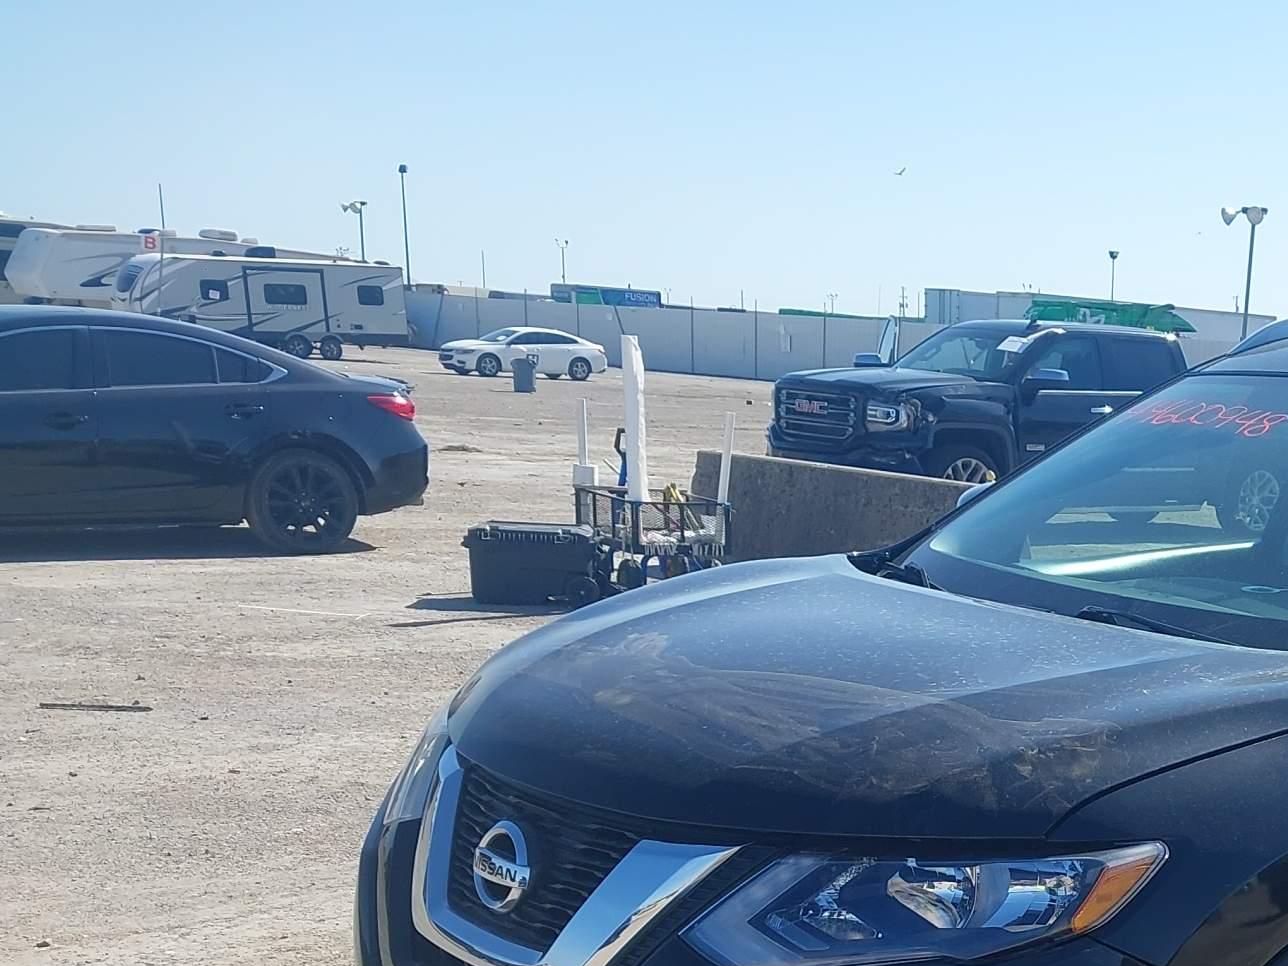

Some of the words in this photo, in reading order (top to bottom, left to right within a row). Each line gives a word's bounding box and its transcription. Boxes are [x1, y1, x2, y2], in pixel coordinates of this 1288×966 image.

[144, 235, 156, 249] B
[624, 292, 657, 302] FUSION
[795, 399, 828, 415] GMC
